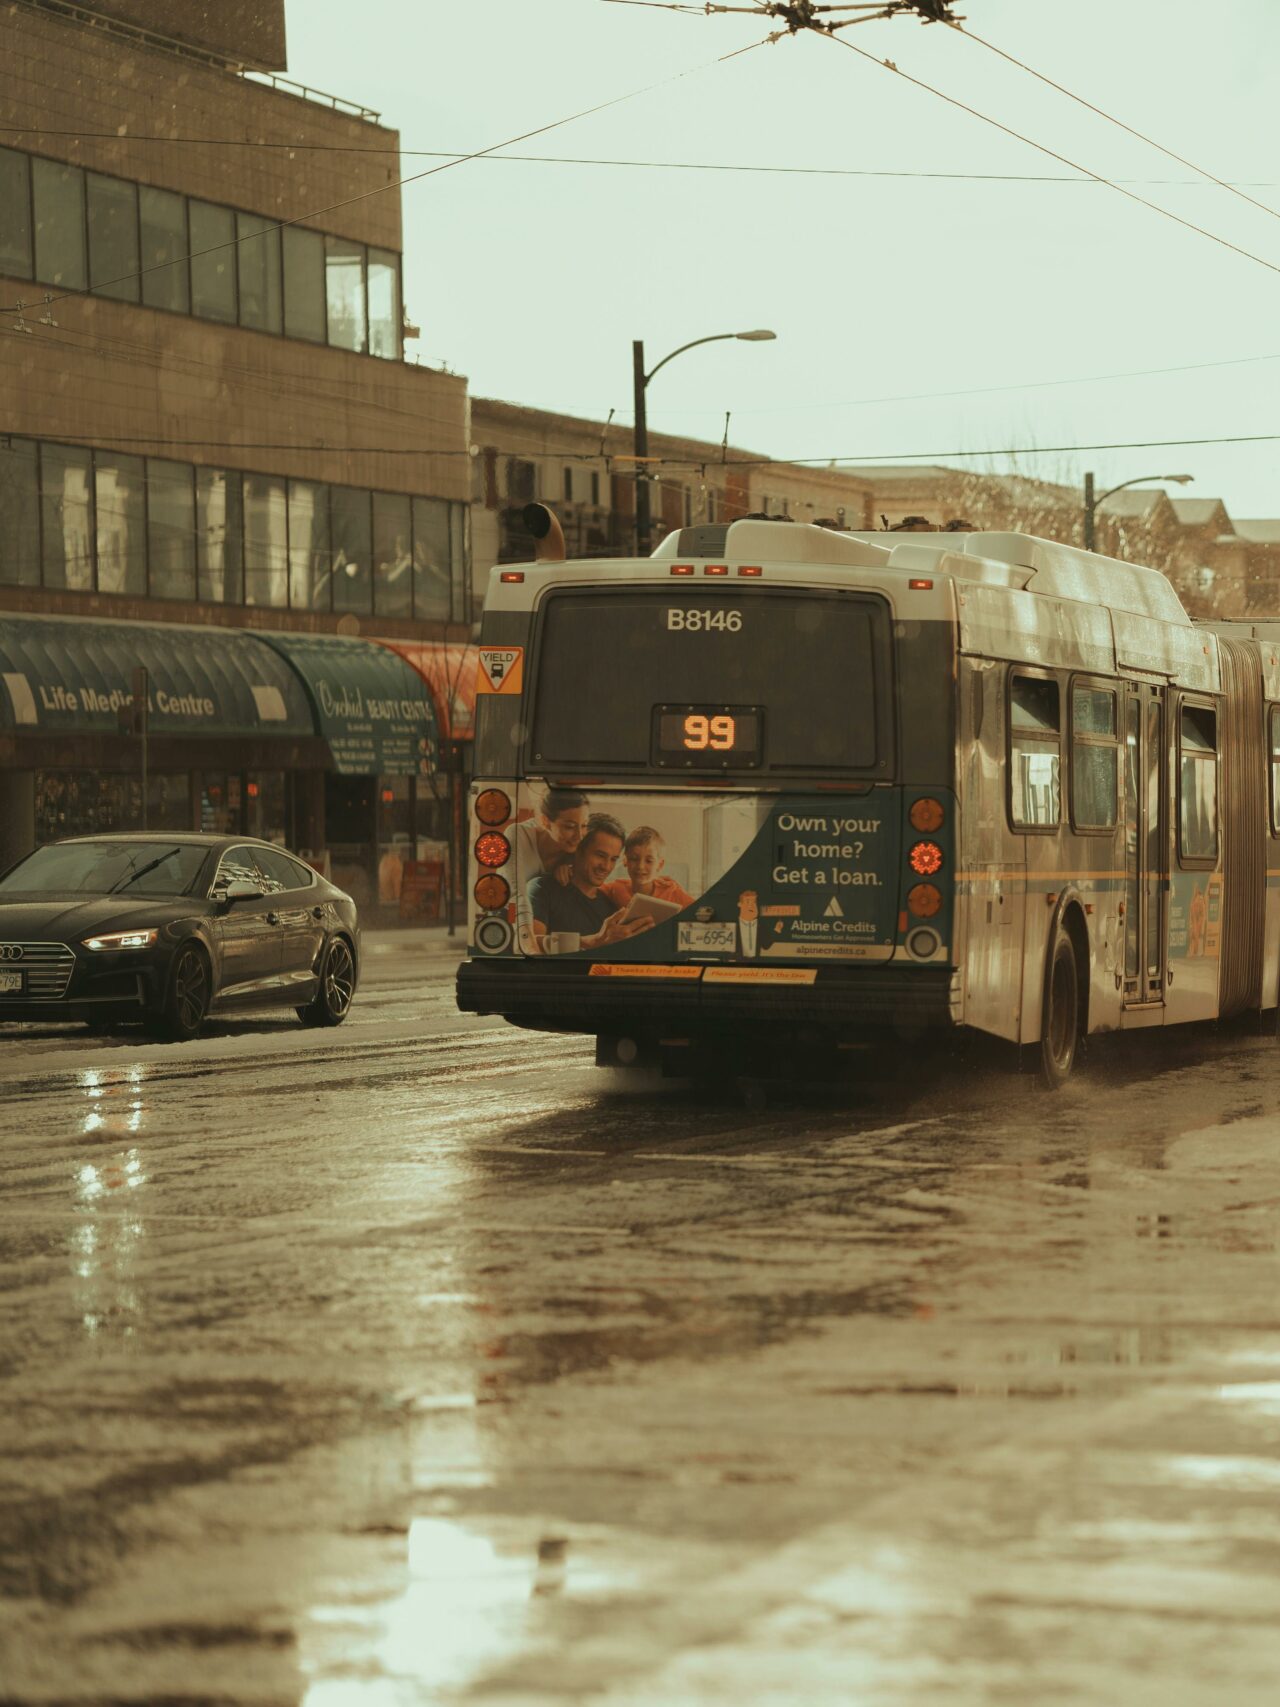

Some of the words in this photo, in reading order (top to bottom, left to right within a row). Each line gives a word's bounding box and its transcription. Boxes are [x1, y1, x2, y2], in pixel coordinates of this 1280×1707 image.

[667, 609, 742, 632] B8146
[482, 652, 514, 663] YIELD
[40, 685, 77, 711] Life
[156, 690, 214, 716] Centre
[366, 699, 400, 720] BEAUTY
[683, 715, 735, 750] 99
[778, 814, 827, 831] Own
[832, 818, 881, 836] your
[793, 840, 864, 858] home?
[773, 866, 808, 884] Get
[814, 870, 827, 884] a
[832, 867, 883, 885] loan.
[790, 920, 830, 933] Alpine
[833, 920, 876, 933] Credits
[796, 945, 866, 956] alpinecredits.ca
